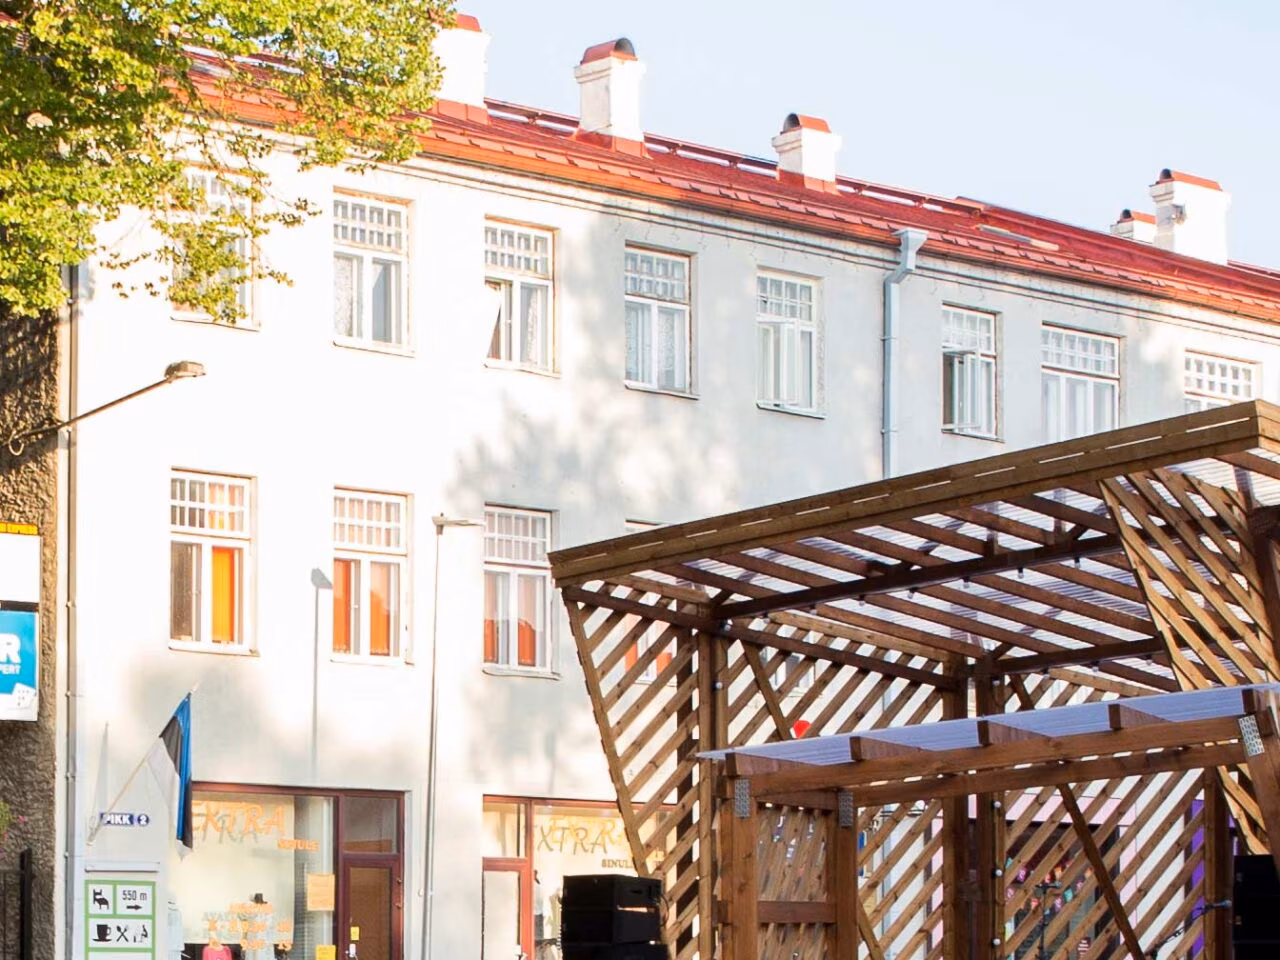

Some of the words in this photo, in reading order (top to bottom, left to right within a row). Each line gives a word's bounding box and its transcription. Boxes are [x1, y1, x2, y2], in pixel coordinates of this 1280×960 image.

[103, 812, 131, 825] PIKK
[139, 813, 148, 825] 2
[122, 890, 137, 901] 550
